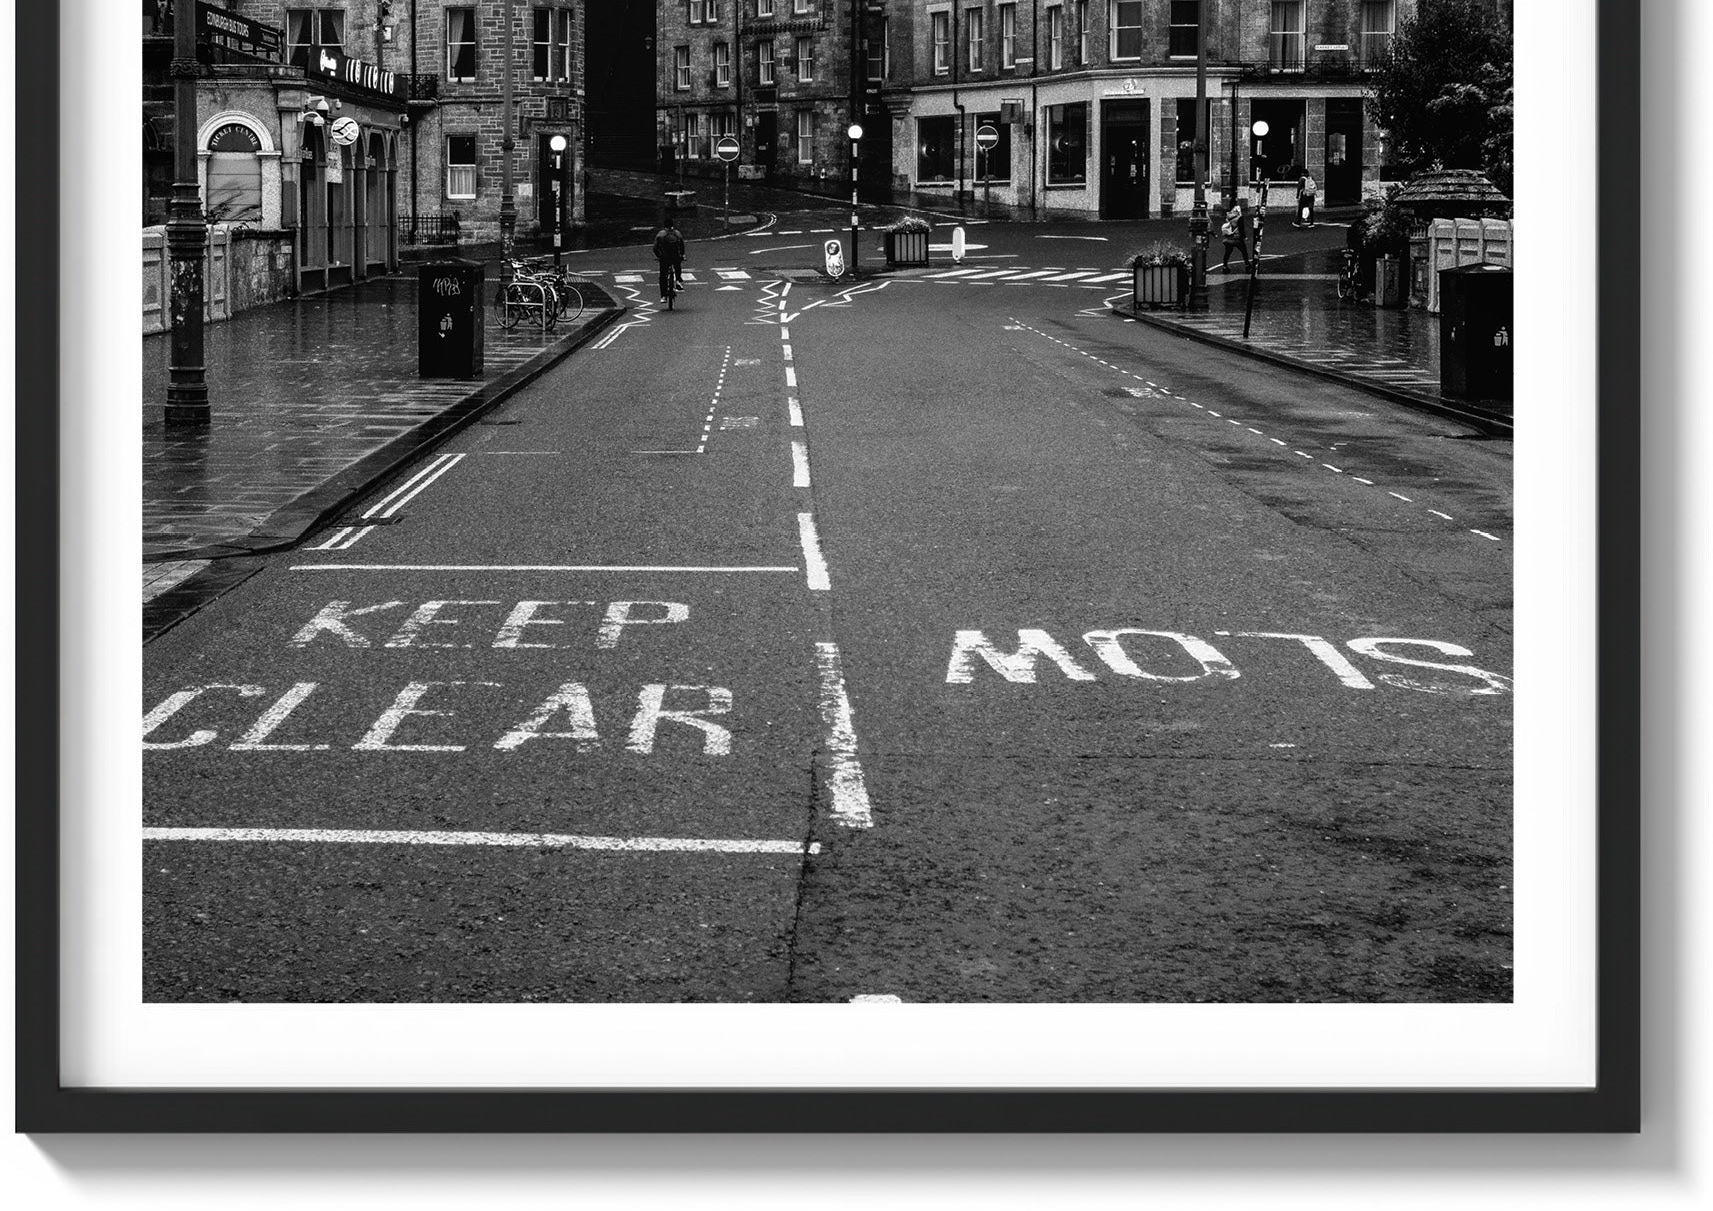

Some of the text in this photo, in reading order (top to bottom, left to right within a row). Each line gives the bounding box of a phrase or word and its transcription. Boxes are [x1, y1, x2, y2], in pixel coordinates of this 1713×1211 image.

[211, 126, 258, 147] TICKET CENTRE
[288, 600, 690, 649] KEEP
[945, 628, 1514, 695] SLOW
[142, 681, 733, 756] CLEAR
